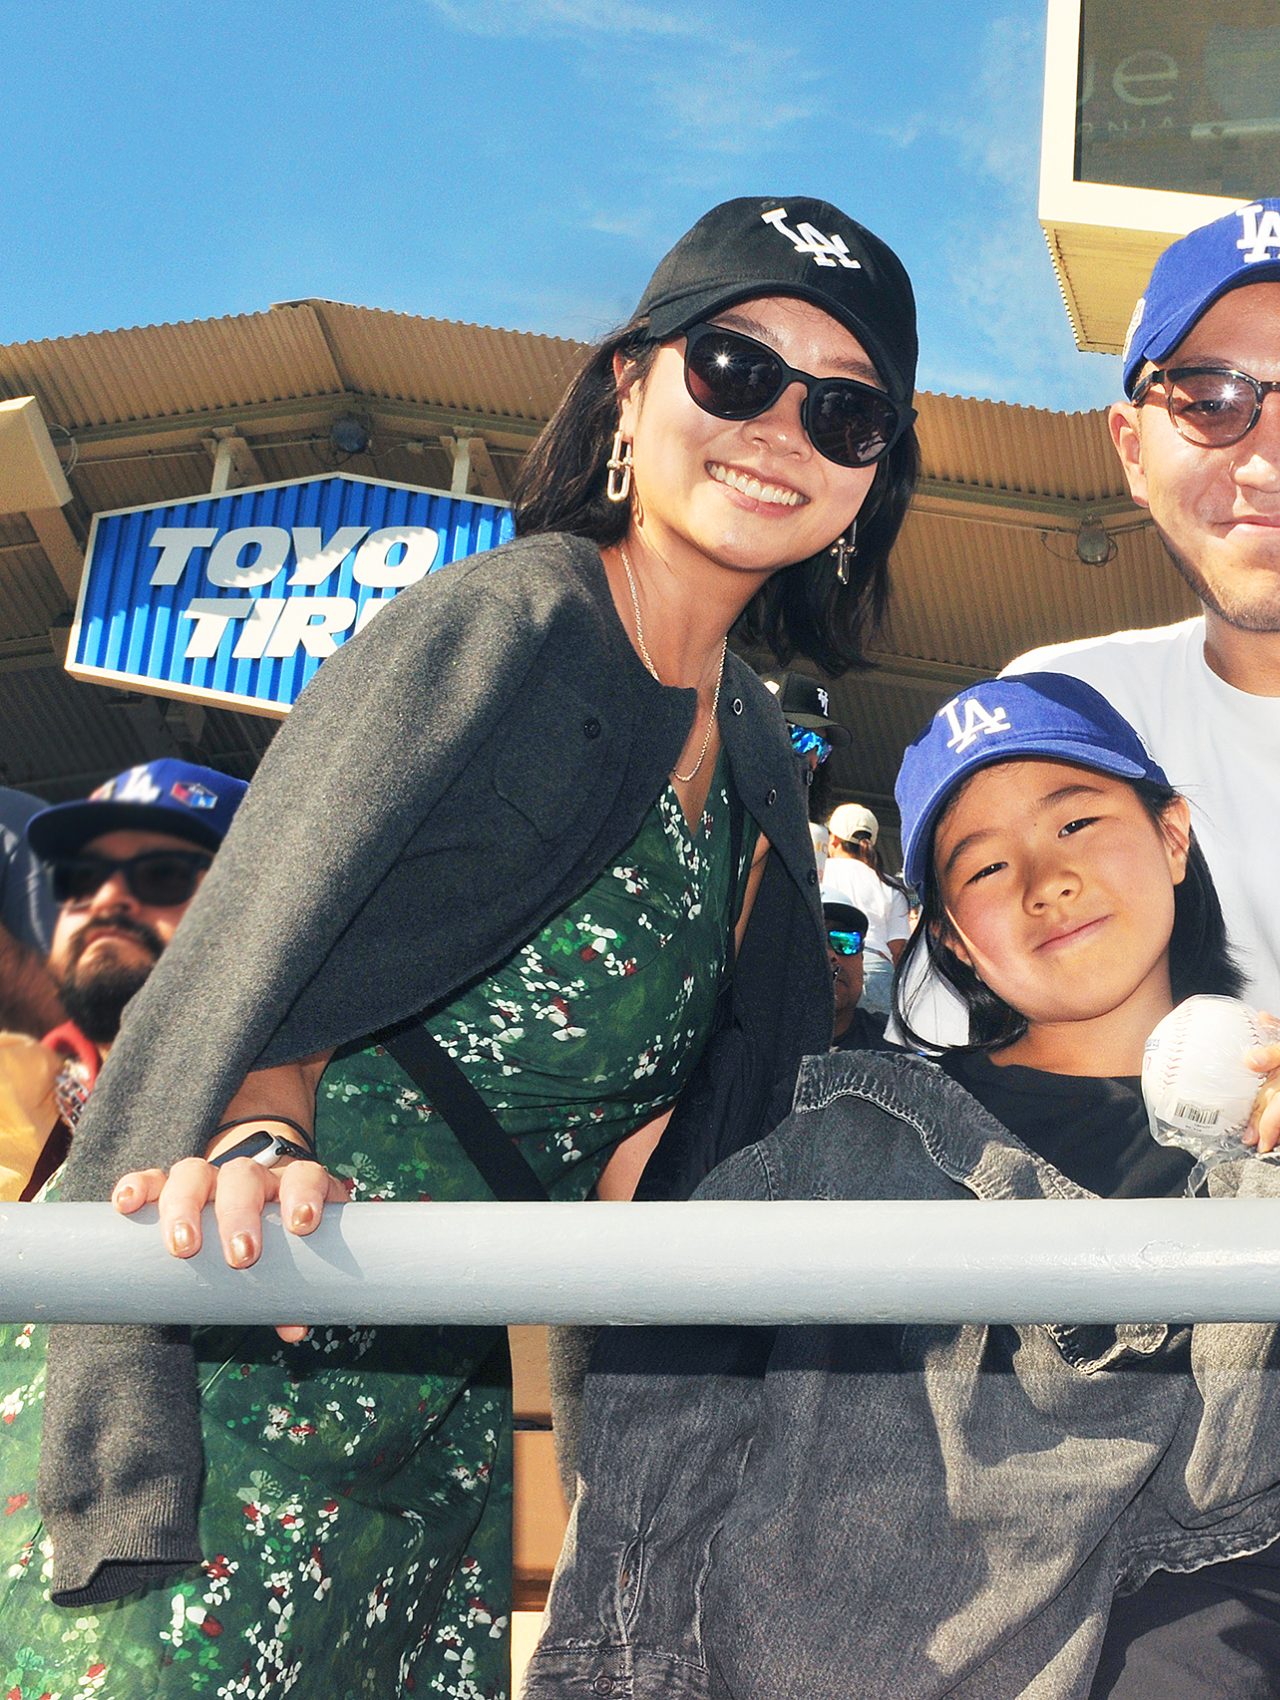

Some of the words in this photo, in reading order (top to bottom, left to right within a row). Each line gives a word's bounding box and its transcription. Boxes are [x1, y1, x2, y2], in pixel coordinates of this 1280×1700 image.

[761, 207, 861, 269] LA
[149, 526, 439, 588] TOYO
[939, 698, 1011, 754] LA
